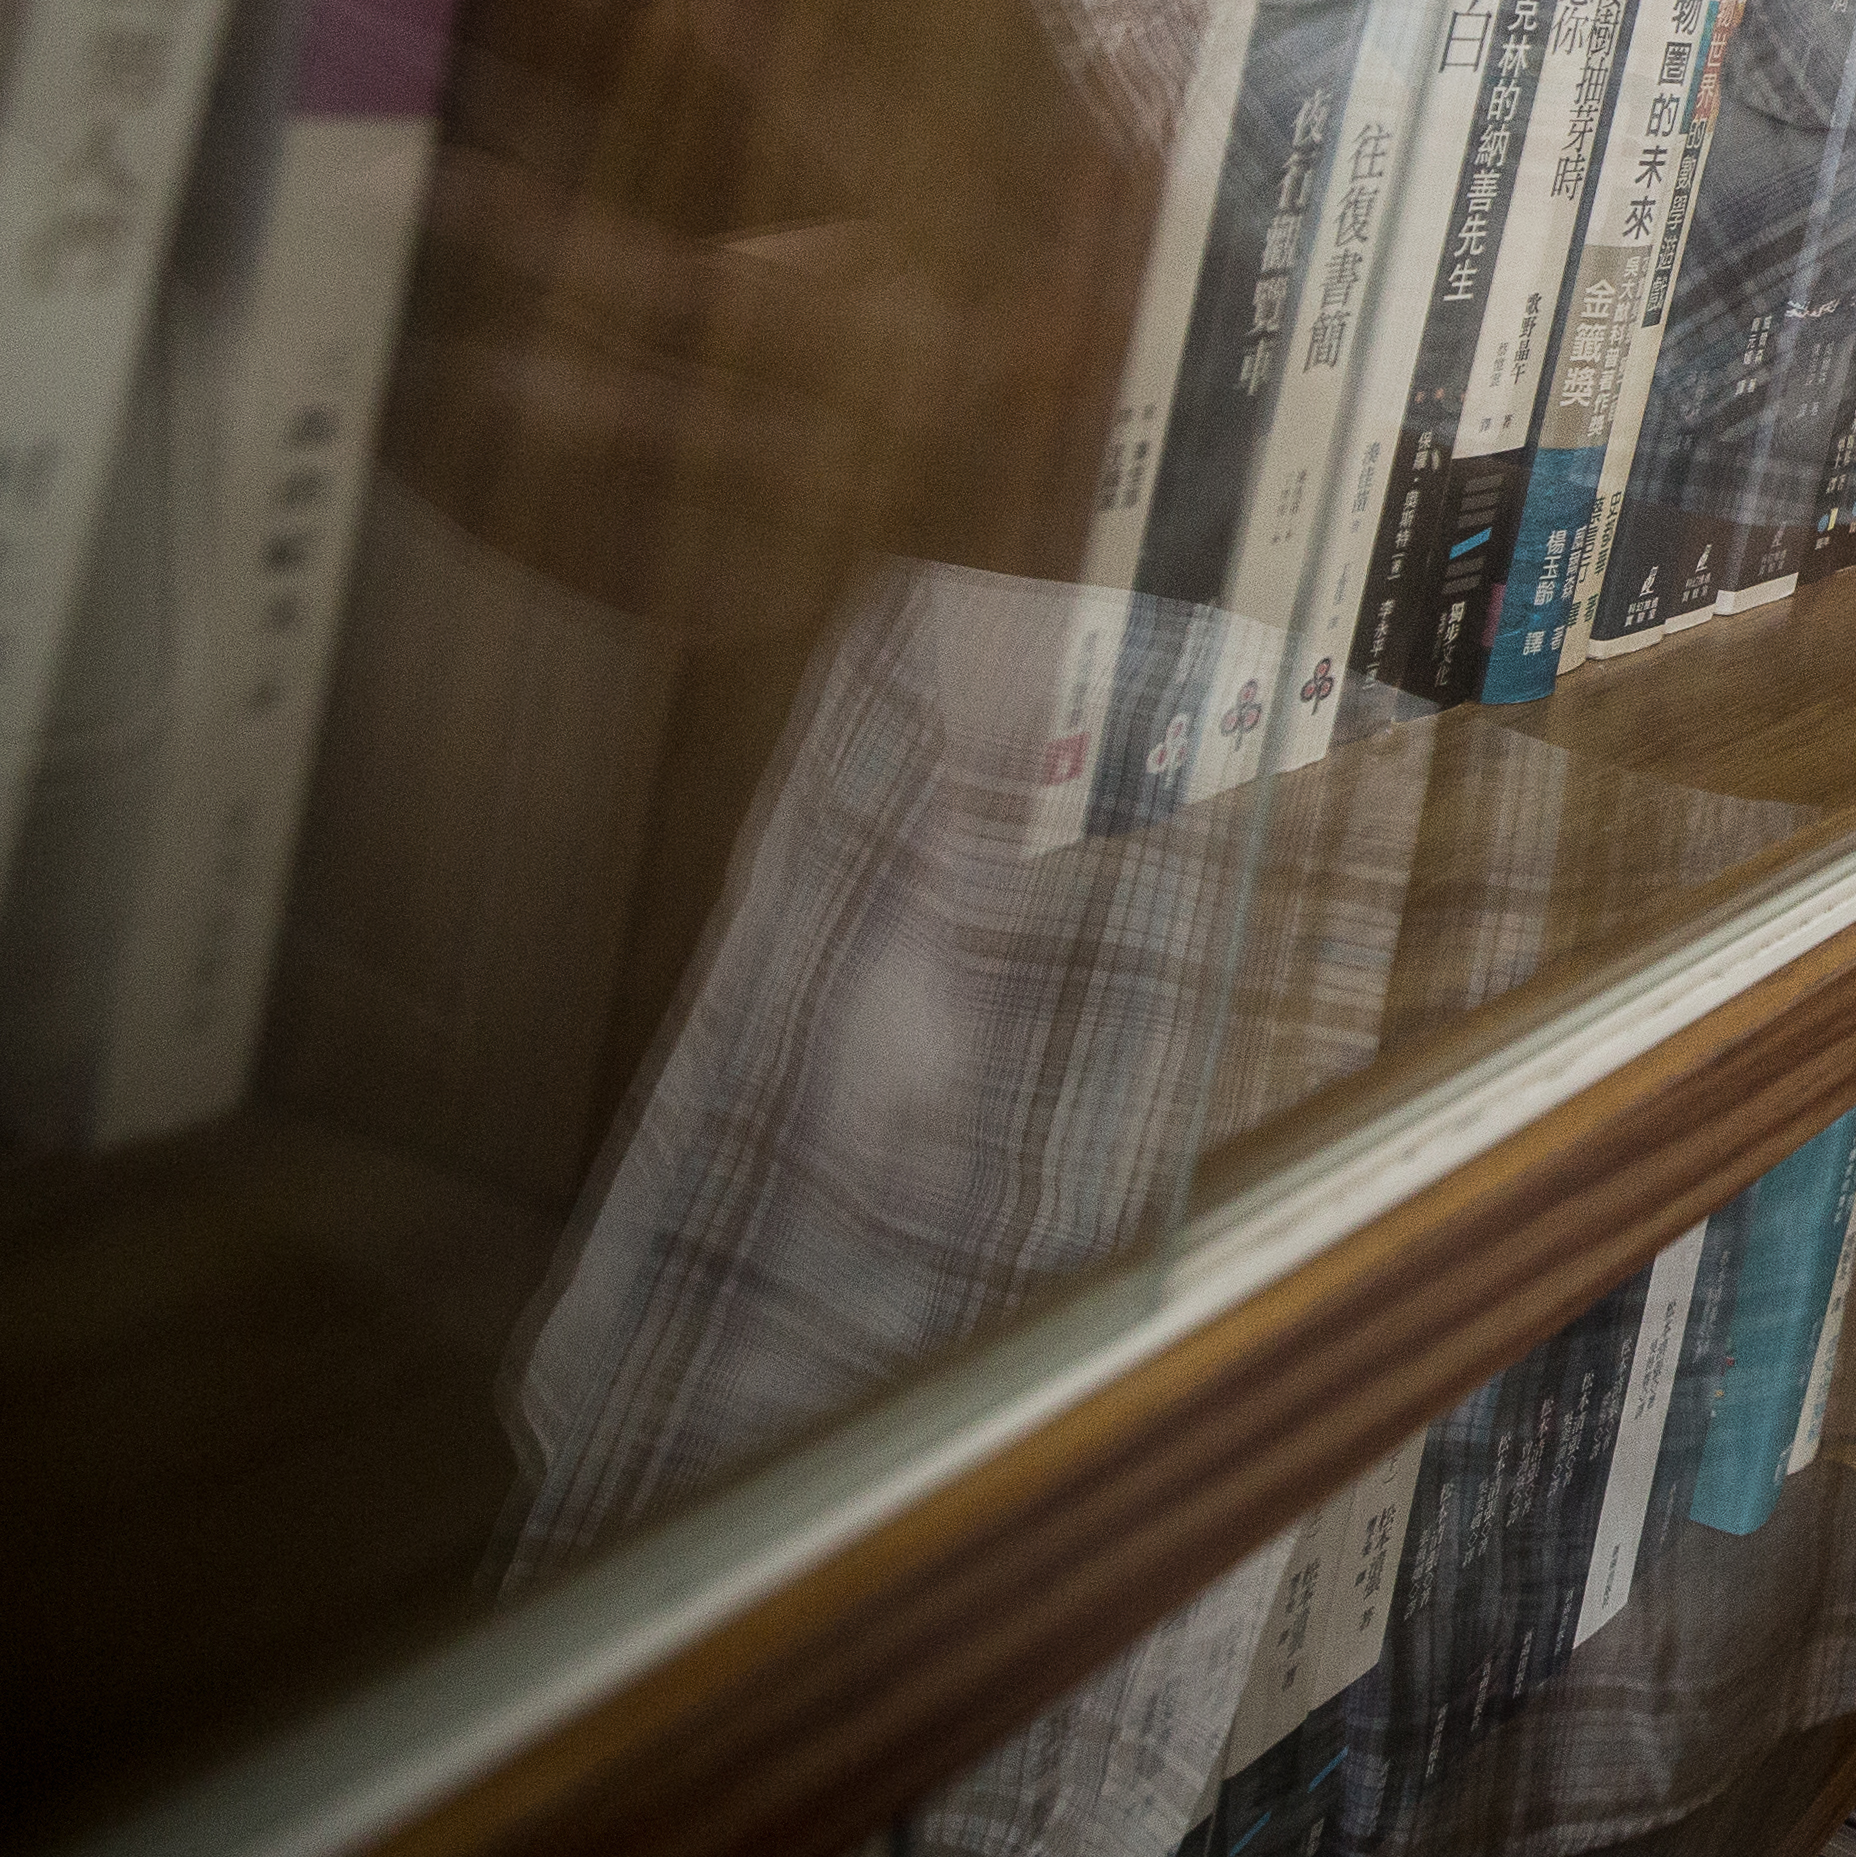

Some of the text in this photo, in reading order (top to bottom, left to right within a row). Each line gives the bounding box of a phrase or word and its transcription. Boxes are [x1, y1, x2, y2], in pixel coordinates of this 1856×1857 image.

[1295, 122, 1400, 374] 往復書簡
[1555, 277, 1621, 409] 金籤獎
[1531, 527, 1569, 607] 楊玉齡
